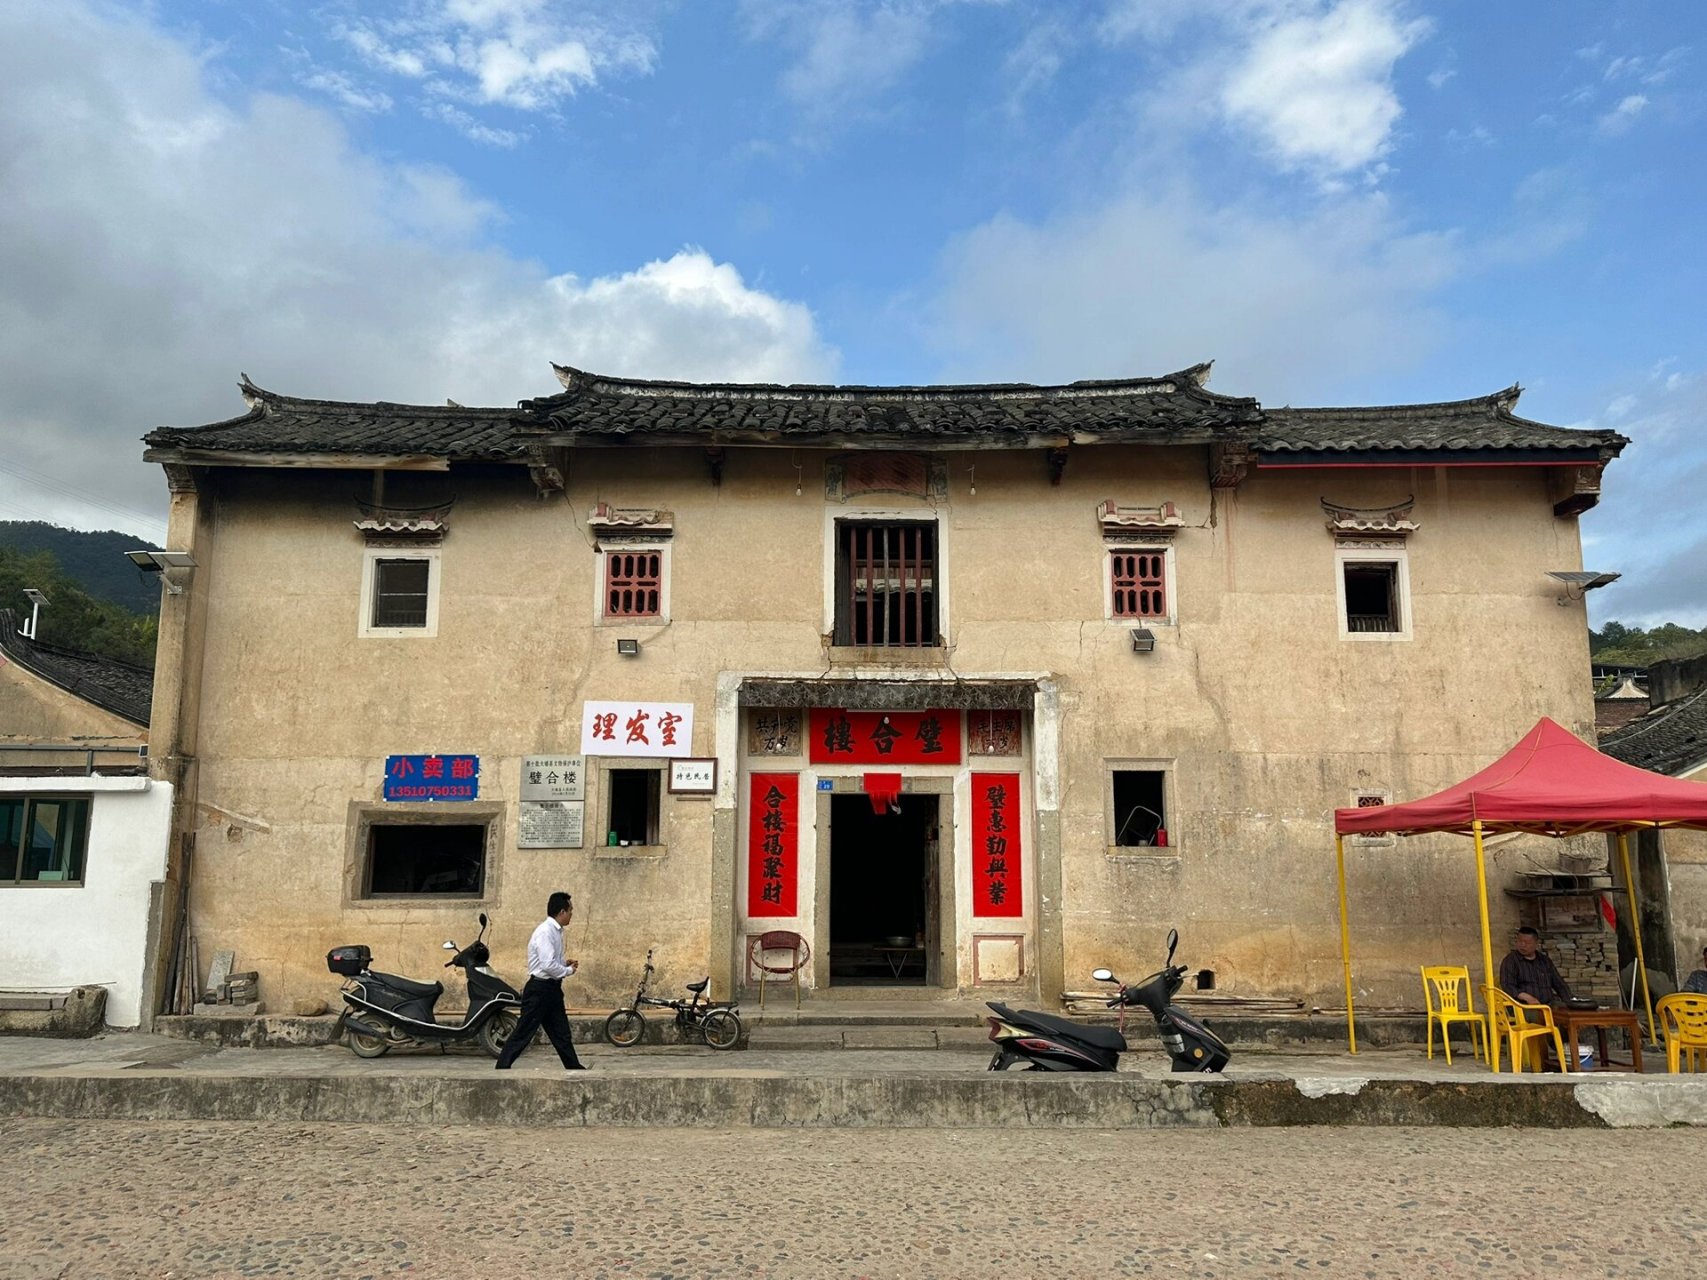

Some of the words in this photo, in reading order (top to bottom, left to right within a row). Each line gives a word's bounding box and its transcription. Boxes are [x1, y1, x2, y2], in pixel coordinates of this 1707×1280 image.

[592, 708, 683, 747] 理发室
[391, 757, 474, 779] 小卖部
[529, 770, 577, 785] 璧合楼
[389, 785, 472, 797] 13510750331
